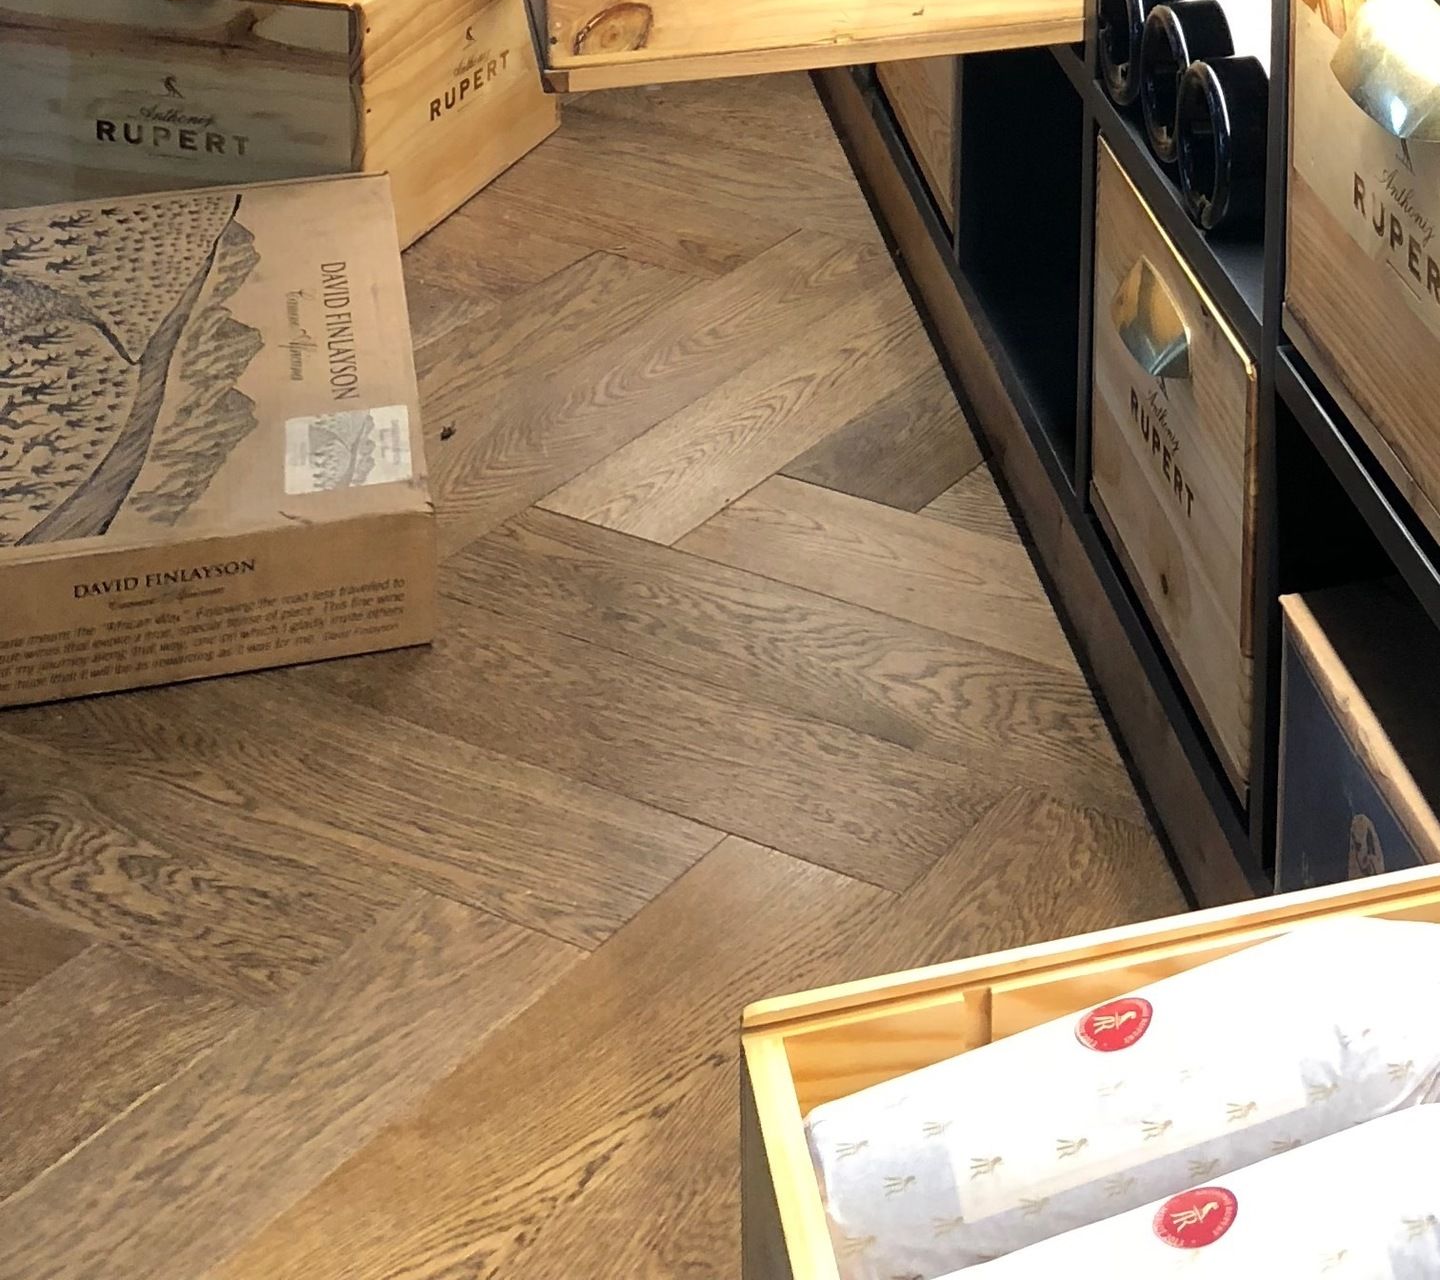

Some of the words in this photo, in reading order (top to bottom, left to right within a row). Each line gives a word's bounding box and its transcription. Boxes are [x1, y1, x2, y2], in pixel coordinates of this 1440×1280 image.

[430, 49, 510, 122] RUPERT
[96, 119, 249, 156] RUPERT
[320, 261, 351, 309] DAVID
[325, 311, 361, 401] FINLAYSON
[1130, 385, 1194, 519] RUPERT
[74, 576, 139, 599] DAVID
[145, 558, 256, 588] FINLAYSON
